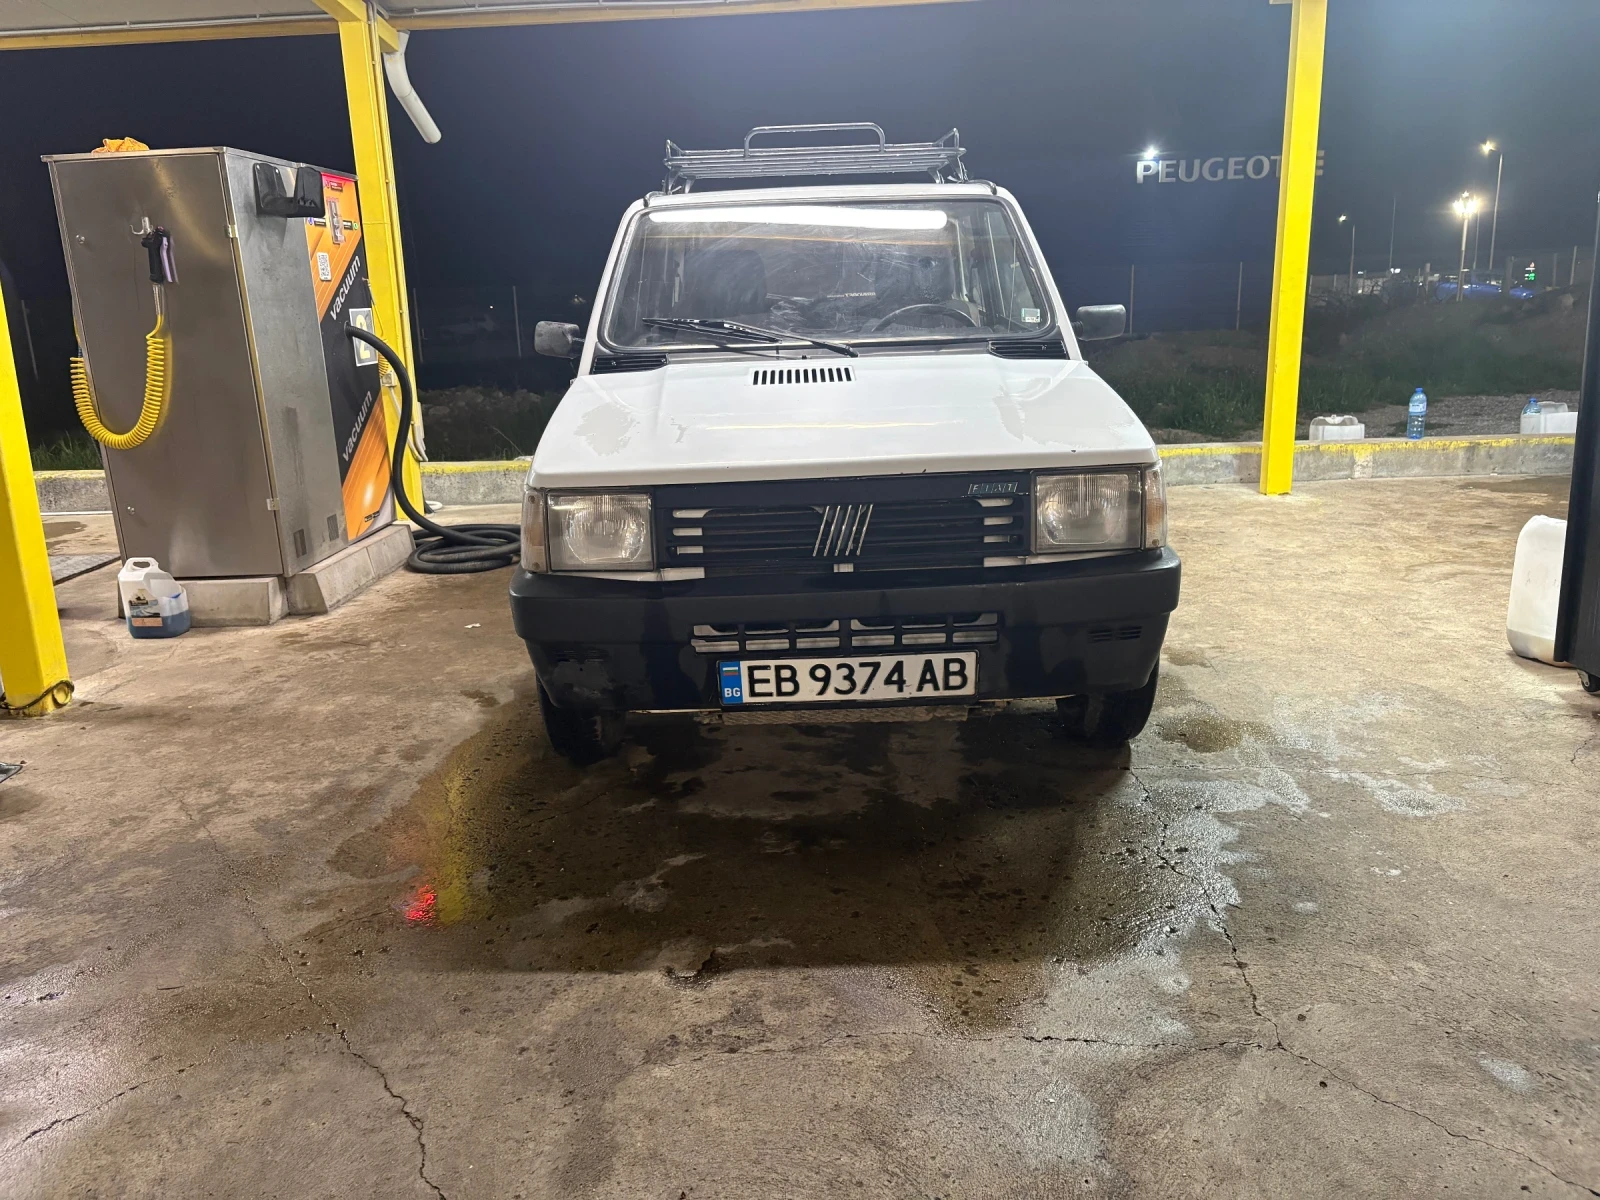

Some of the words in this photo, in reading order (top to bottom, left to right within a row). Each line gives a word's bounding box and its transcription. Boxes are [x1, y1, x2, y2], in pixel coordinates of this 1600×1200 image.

[1136, 155, 1282, 184] PEUGEOT
[329, 255, 362, 321] vacuum
[342, 390, 373, 462] vacuum
[970, 482, 1015, 494] FIAT
[724, 687, 741, 698] BG
[747, 664, 800, 698] EB
[808, 660, 907, 696] 9374
[916, 657, 969, 693] AB
